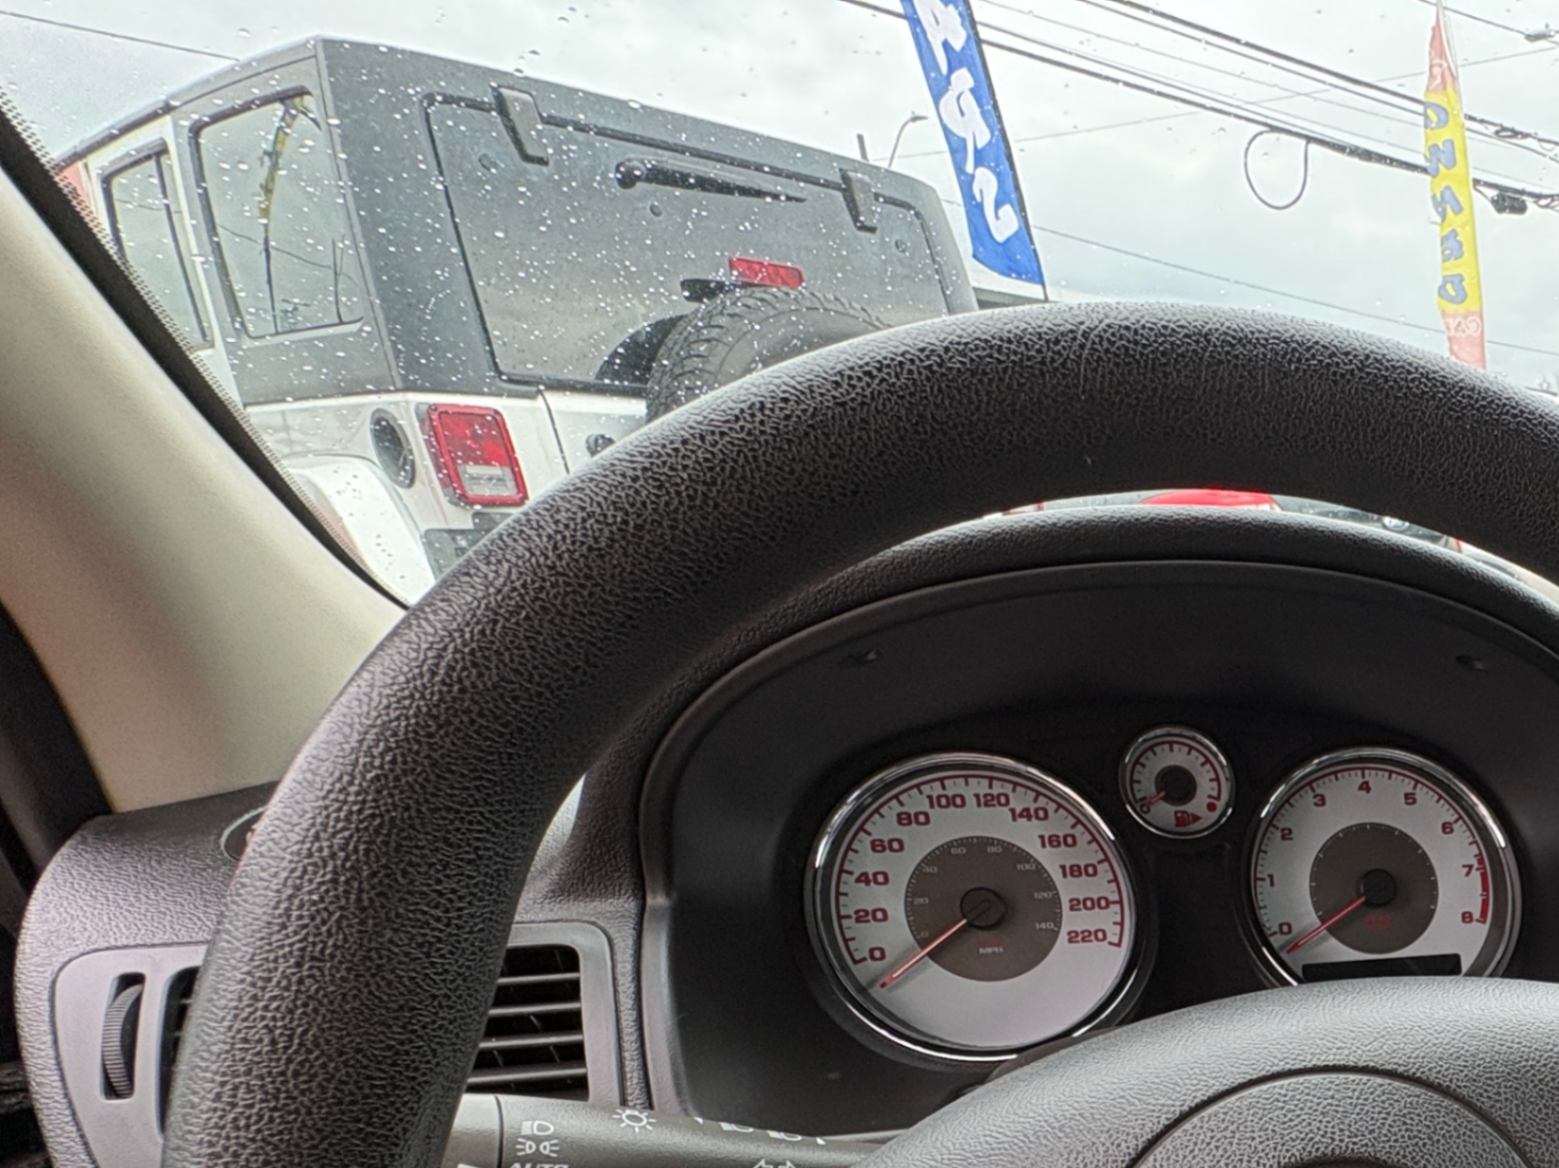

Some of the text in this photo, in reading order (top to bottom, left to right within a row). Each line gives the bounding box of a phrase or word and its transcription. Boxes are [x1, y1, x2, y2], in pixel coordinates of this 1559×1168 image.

[1358, 780, 1371, 794] 4
[926, 793, 966, 809] 100
[973, 792, 1010, 808] 120
[1314, 793, 1326, 807] 3
[1404, 792, 1417, 806] 5
[896, 811, 931, 827] 80
[1010, 807, 1049, 822] 140
[1280, 827, 1294, 841] 2
[1441, 821, 1454, 835] 6
[870, 838, 905, 853] 60
[1038, 834, 1077, 849] 160
[855, 870, 889, 886] 40
[1060, 863, 1098, 878] 180
[1462, 864, 1474, 877] 7
[1266, 873, 1276, 888] 1
[1069, 896, 1109, 911] 200
[855, 908, 889, 923] 20
[1461, 911, 1473, 925] 8
[1067, 929, 1107, 944] 220
[1279, 922, 1291, 936] 0
[869, 946, 886, 962] 0
